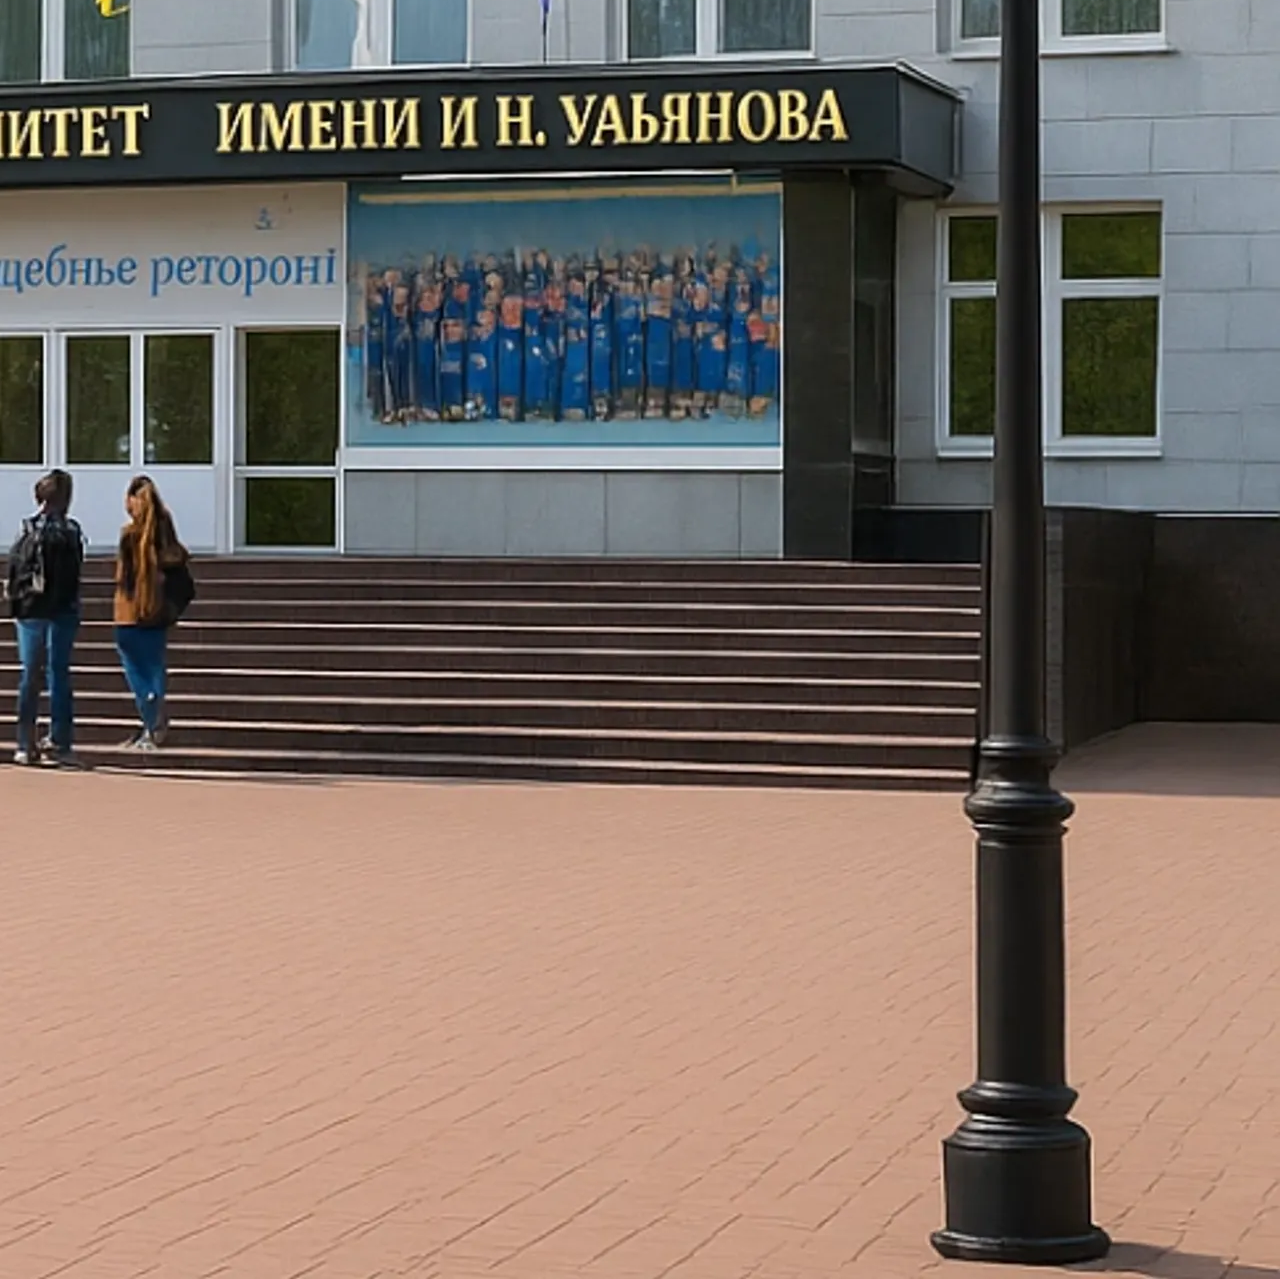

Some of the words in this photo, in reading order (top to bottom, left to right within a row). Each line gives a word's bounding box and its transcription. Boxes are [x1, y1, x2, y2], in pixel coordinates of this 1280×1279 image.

[216, 98, 421, 152] ИМЕНИ
[440, 96, 478, 148] И
[496, 95, 546, 146] Н.
